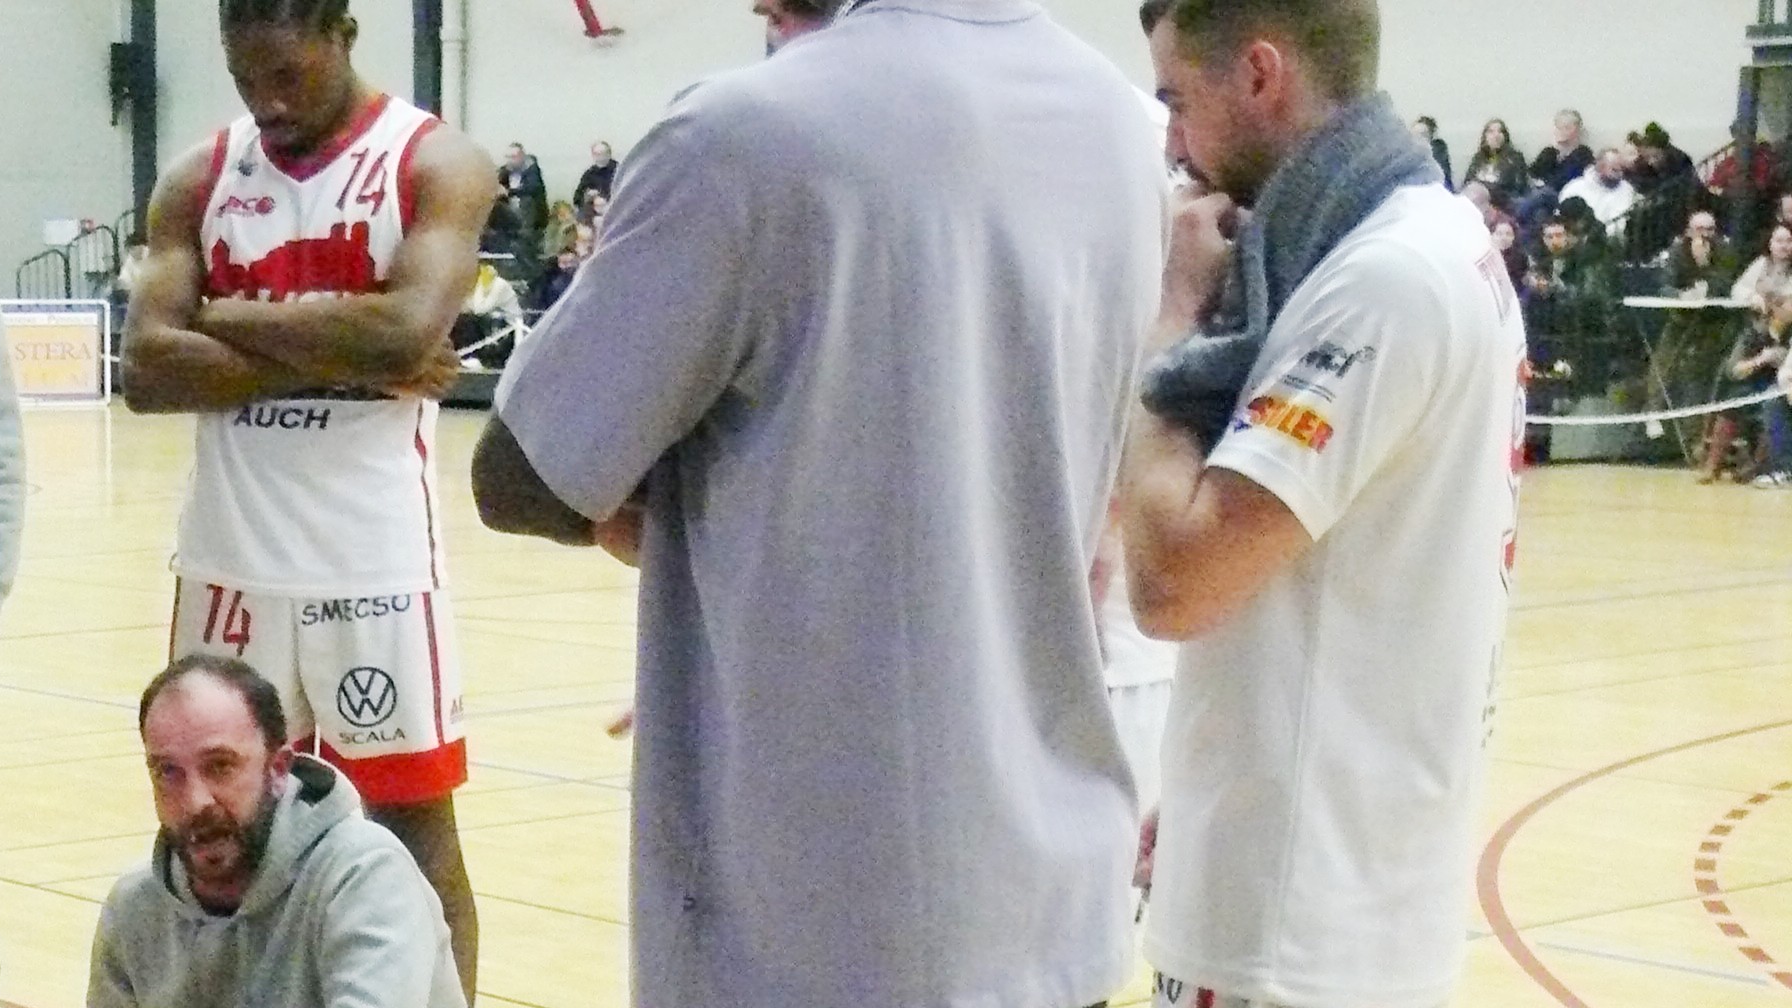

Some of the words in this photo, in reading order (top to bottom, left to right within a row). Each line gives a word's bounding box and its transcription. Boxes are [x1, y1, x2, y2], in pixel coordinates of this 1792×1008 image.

[335, 148, 388, 216] 14
[234, 406, 331, 431] AUCH
[203, 584, 251, 656] 14
[339, 727, 406, 745] SCALA
